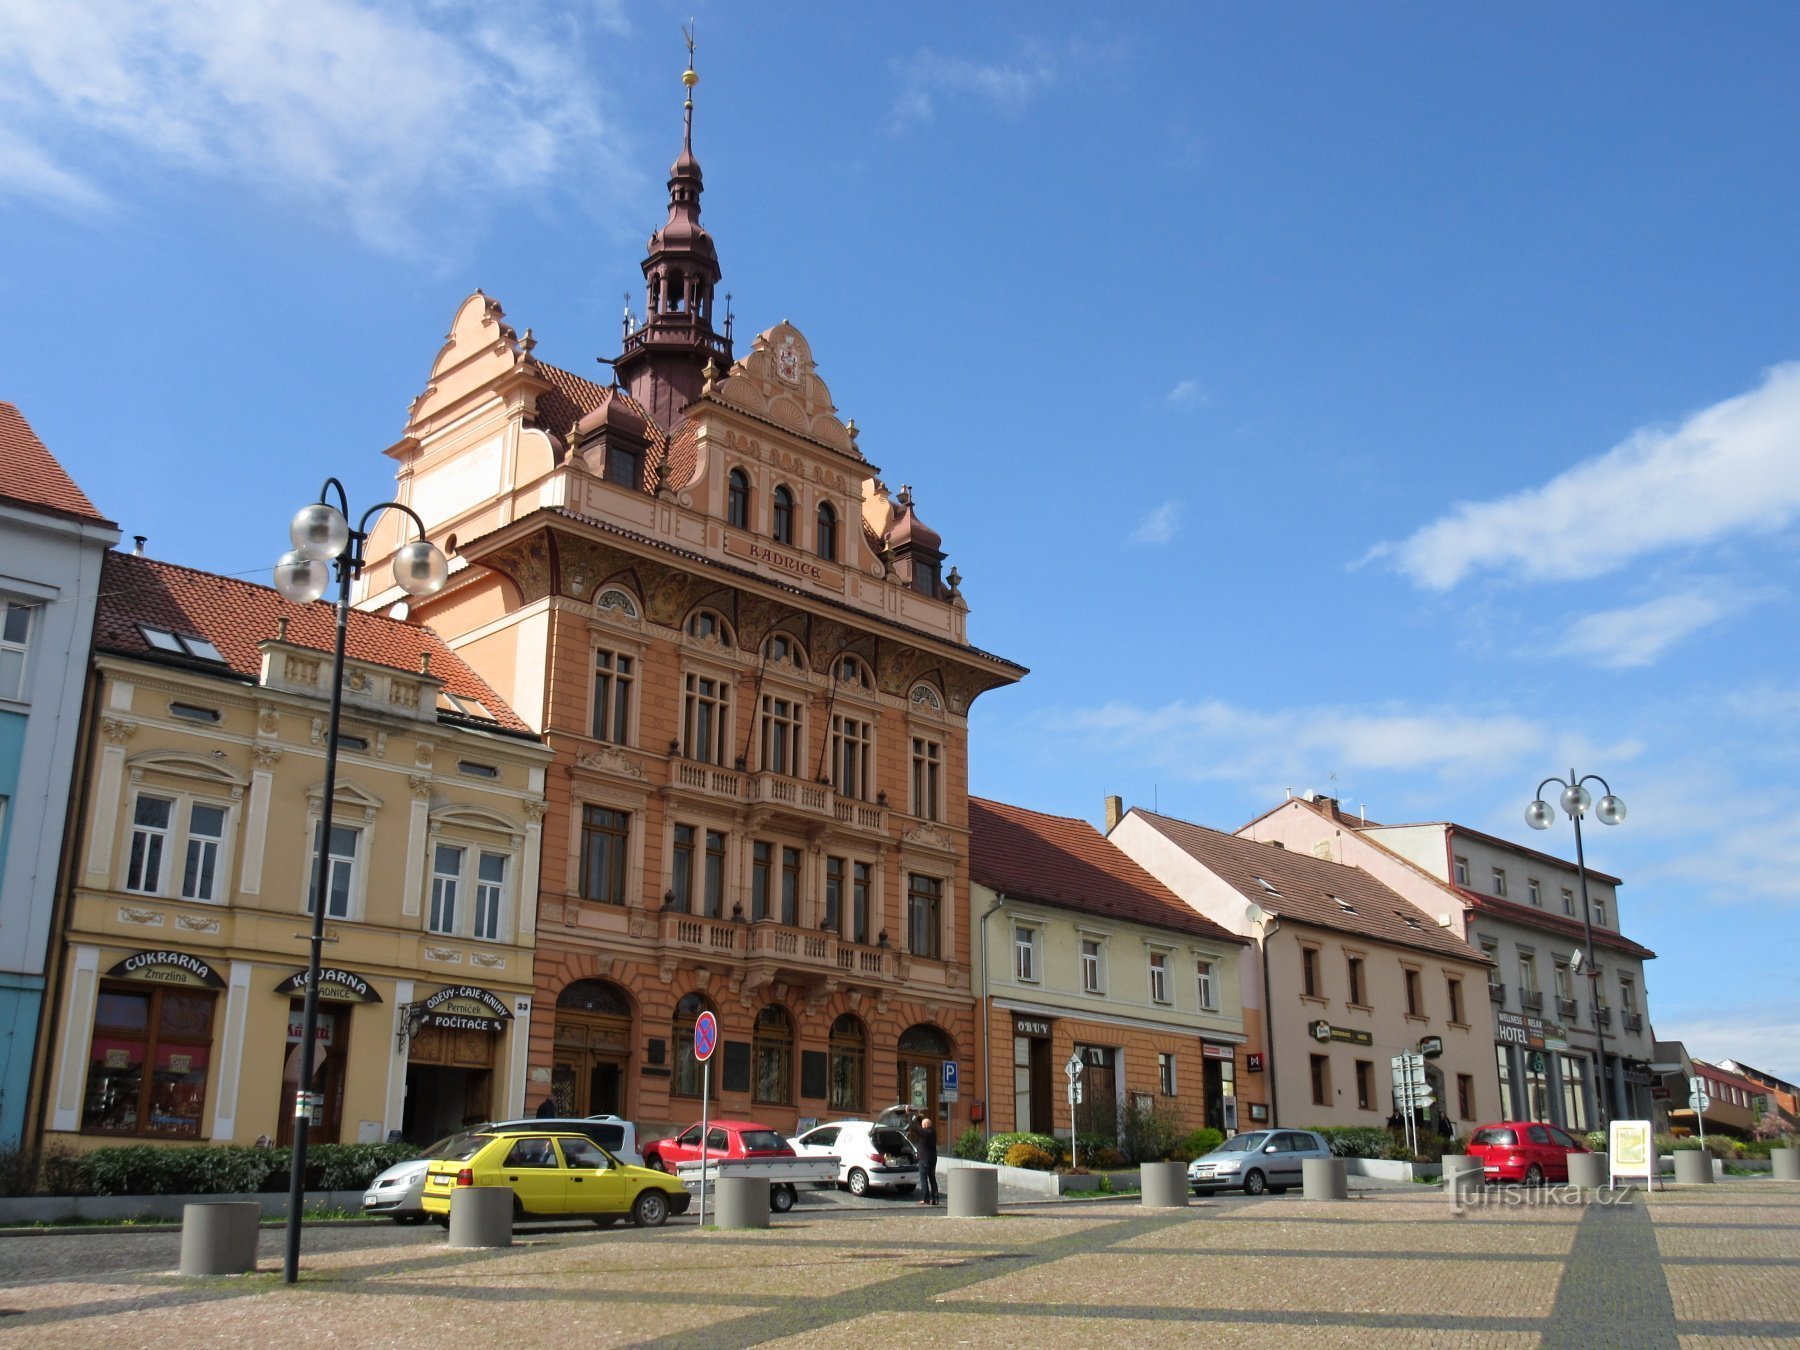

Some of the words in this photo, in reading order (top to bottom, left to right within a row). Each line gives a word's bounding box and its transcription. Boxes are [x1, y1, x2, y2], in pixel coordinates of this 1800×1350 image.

[750, 544, 821, 579] RADNICE
[145, 968, 187, 983] Zmrzlina
[484, 994, 508, 1016] KNIHY
[517, 1002, 528, 1011] 33
[1018, 1021, 1048, 1034] OBUV
[1499, 1025, 1528, 1044] HOTEL
[946, 1064, 955, 1081] P
